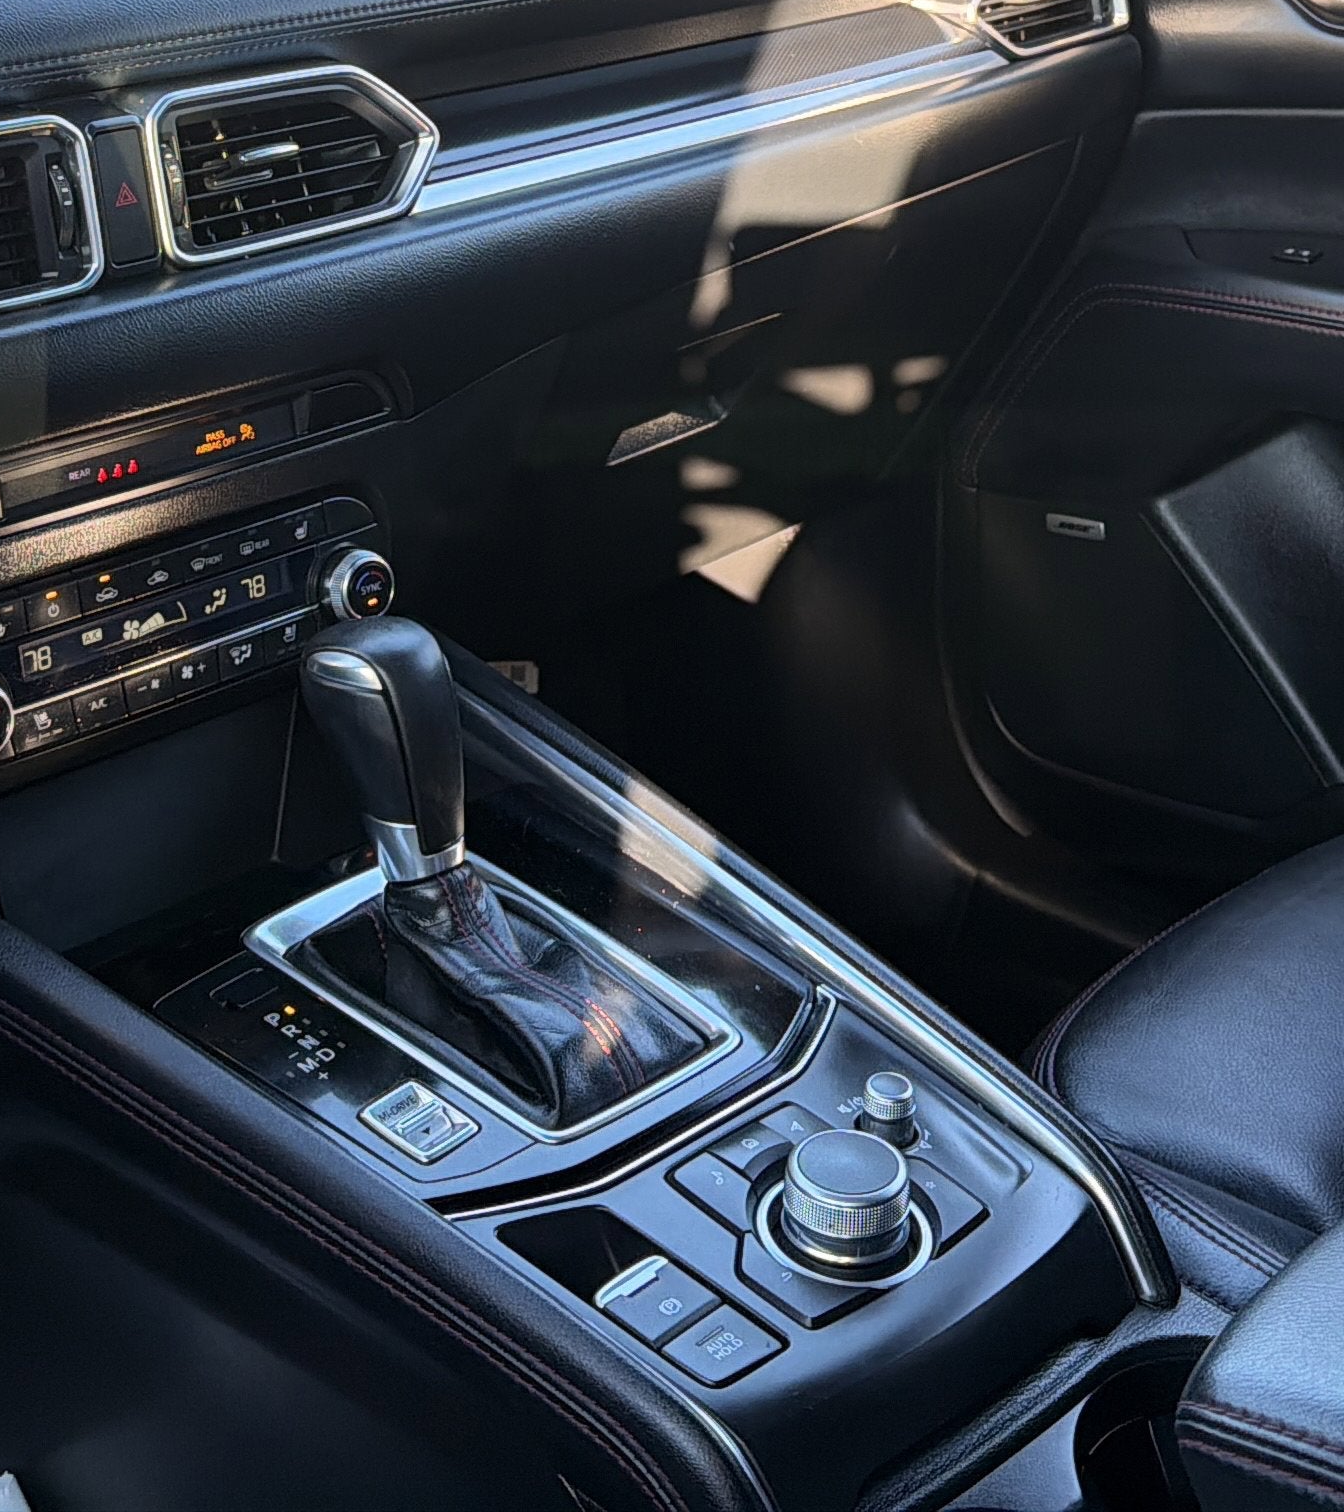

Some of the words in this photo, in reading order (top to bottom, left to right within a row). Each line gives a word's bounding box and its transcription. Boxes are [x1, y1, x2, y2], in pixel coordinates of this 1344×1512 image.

[205, 429, 226, 443] PASS
[222, 435, 237, 448] OFF
[68, 468, 91, 481] REAR
[240, 574, 267, 600] 78
[360, 583, 383, 596] SYNC
[24, 646, 52, 672] 78
[87, 697, 109, 712] A/C
[263, 1012, 282, 1028] P
[281, 1024, 303, 1038] R
[296, 1034, 322, 1051] N
[315, 1047, 336, 1063] D
[706, 1332, 735, 1355] AUTO
[712, 1338, 744, 1361] HOLD
